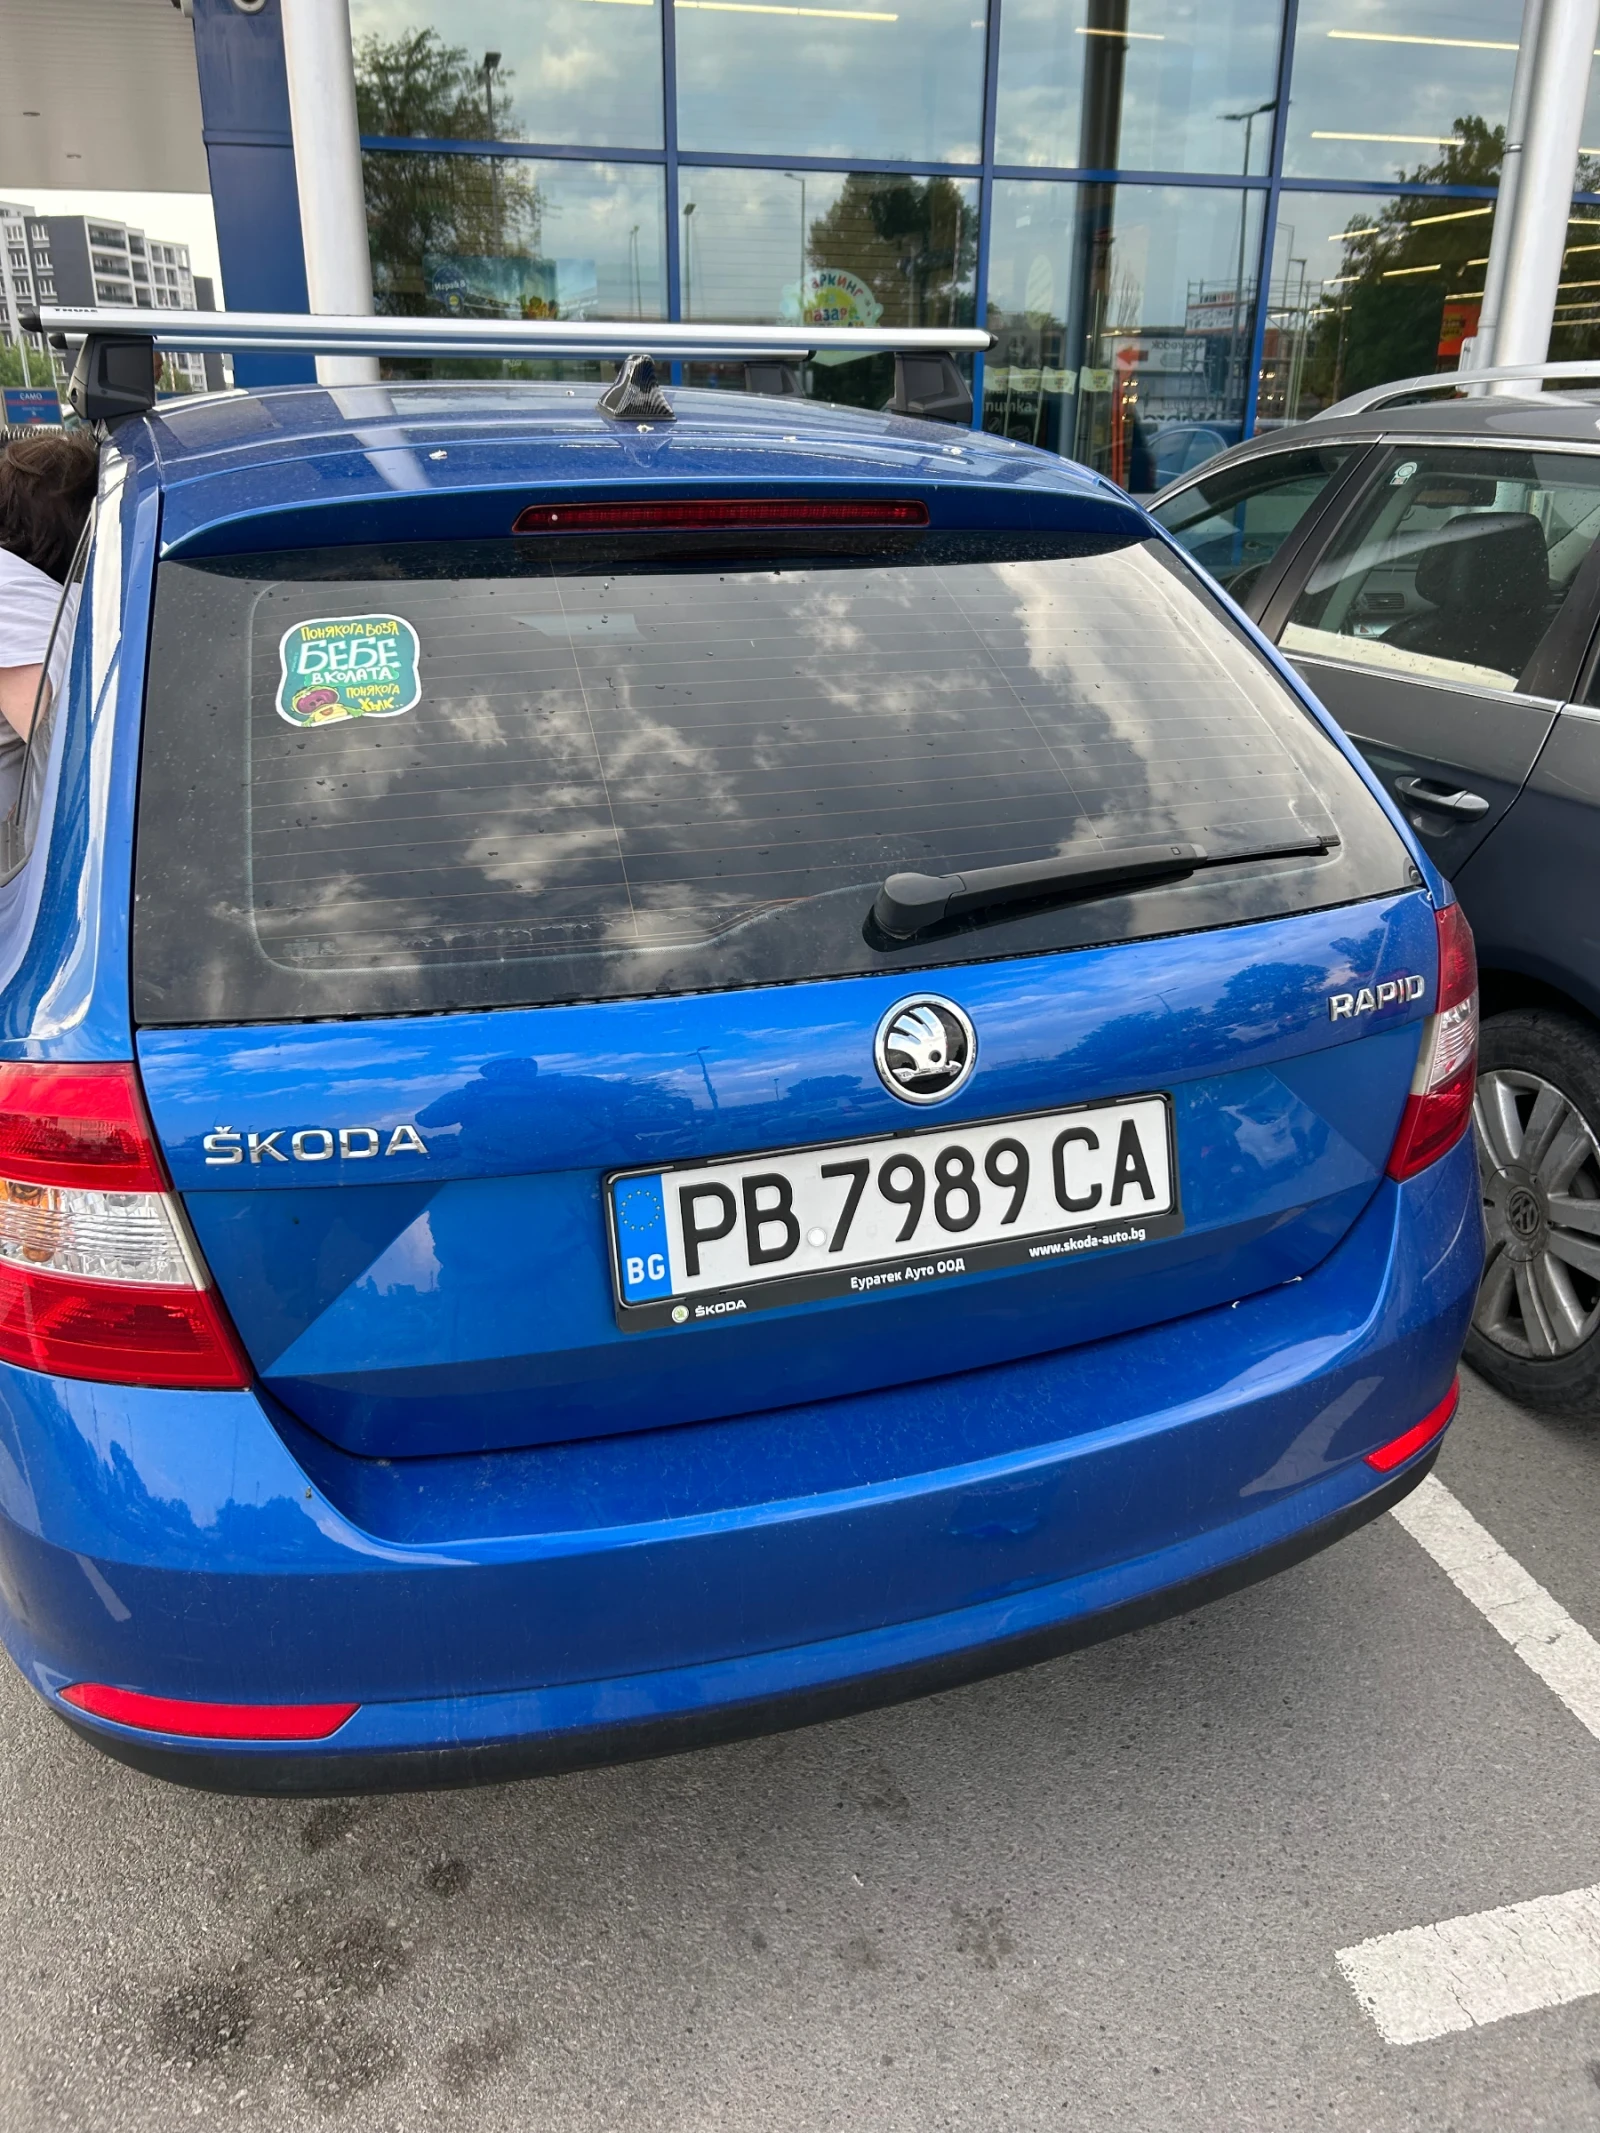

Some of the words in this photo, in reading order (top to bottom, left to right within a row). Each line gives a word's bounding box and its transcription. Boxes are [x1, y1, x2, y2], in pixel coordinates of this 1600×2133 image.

[807, 273, 864, 296] аркинг
[297, 637, 402, 675] БЕБЕ
[1328, 974, 1426, 1021] RAPID
[202, 1124, 429, 1165] ŠKODA
[678, 1173, 800, 1277] PB
[820, 1137, 1031, 1254] 7989
[1052, 1118, 1156, 1213] CA
[1028, 1226, 1146, 1258] www.skoda-auto.bg
[627, 1253, 666, 1285] BG
[850, 1271, 903, 1291] Еуратек
[904, 1266, 935, 1281] Ауто
[936, 1257, 966, 1274] ООД
[695, 1299, 748, 1317] ŠKODA
